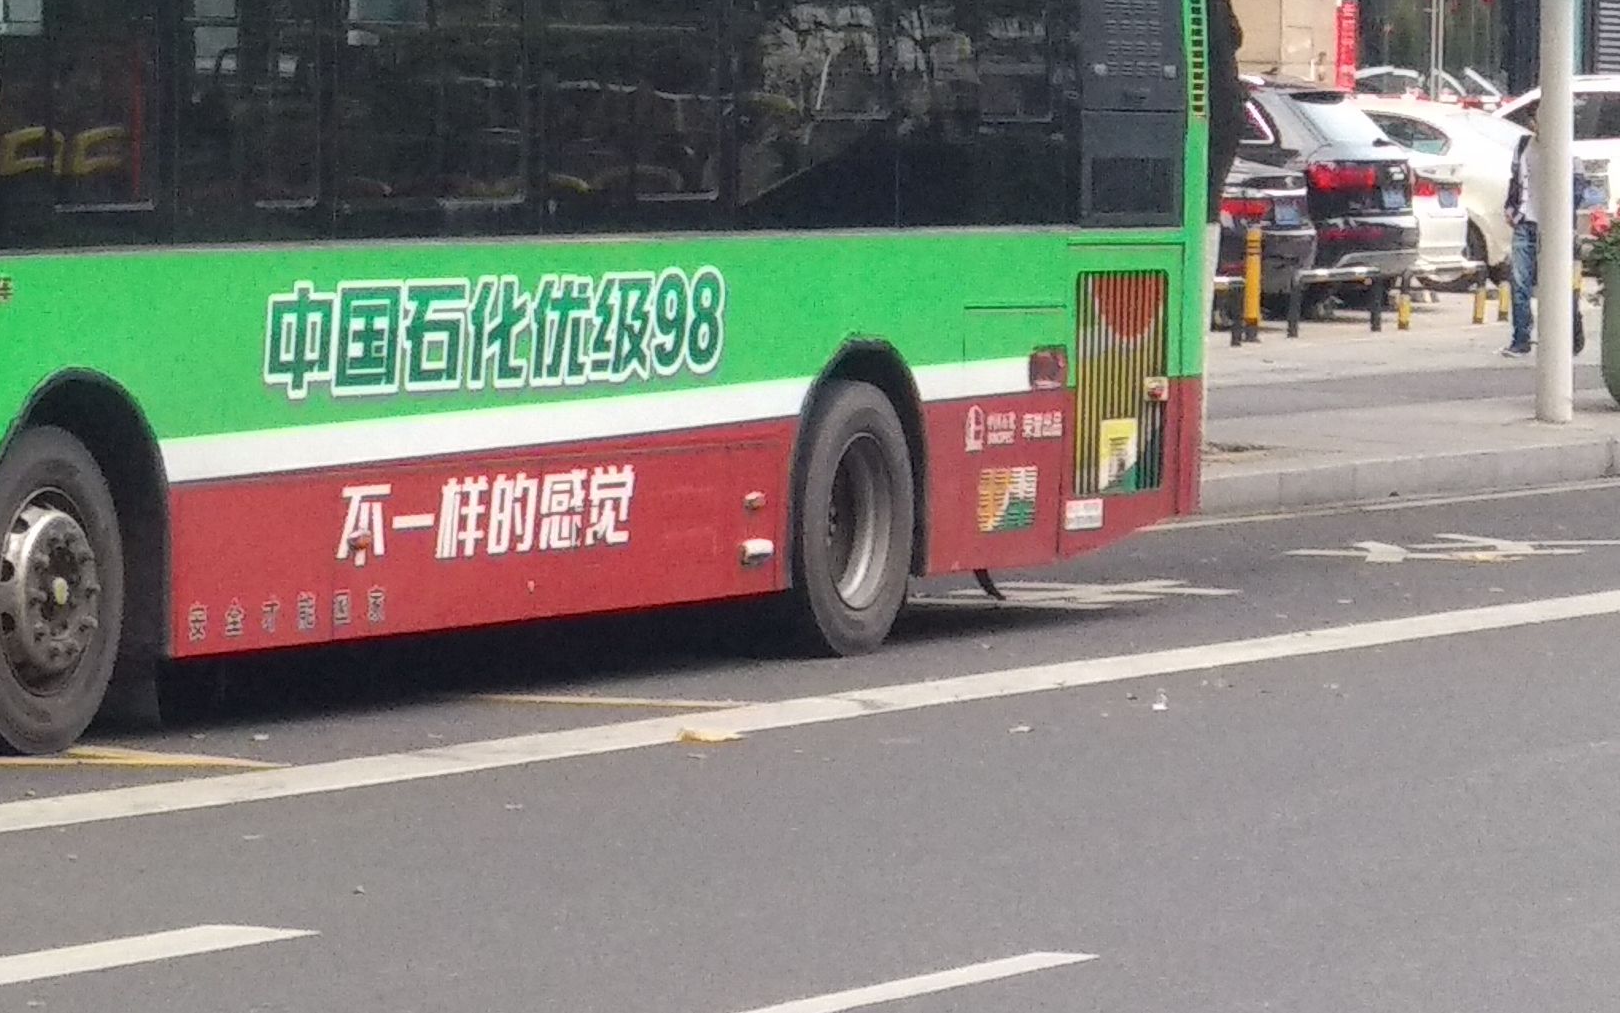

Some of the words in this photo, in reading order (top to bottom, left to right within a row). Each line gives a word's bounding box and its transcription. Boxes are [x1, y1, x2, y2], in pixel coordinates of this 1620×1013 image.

[264, 265, 726, 399] 中国石化优级98
[336, 464, 636, 565] 不一样的感觉
